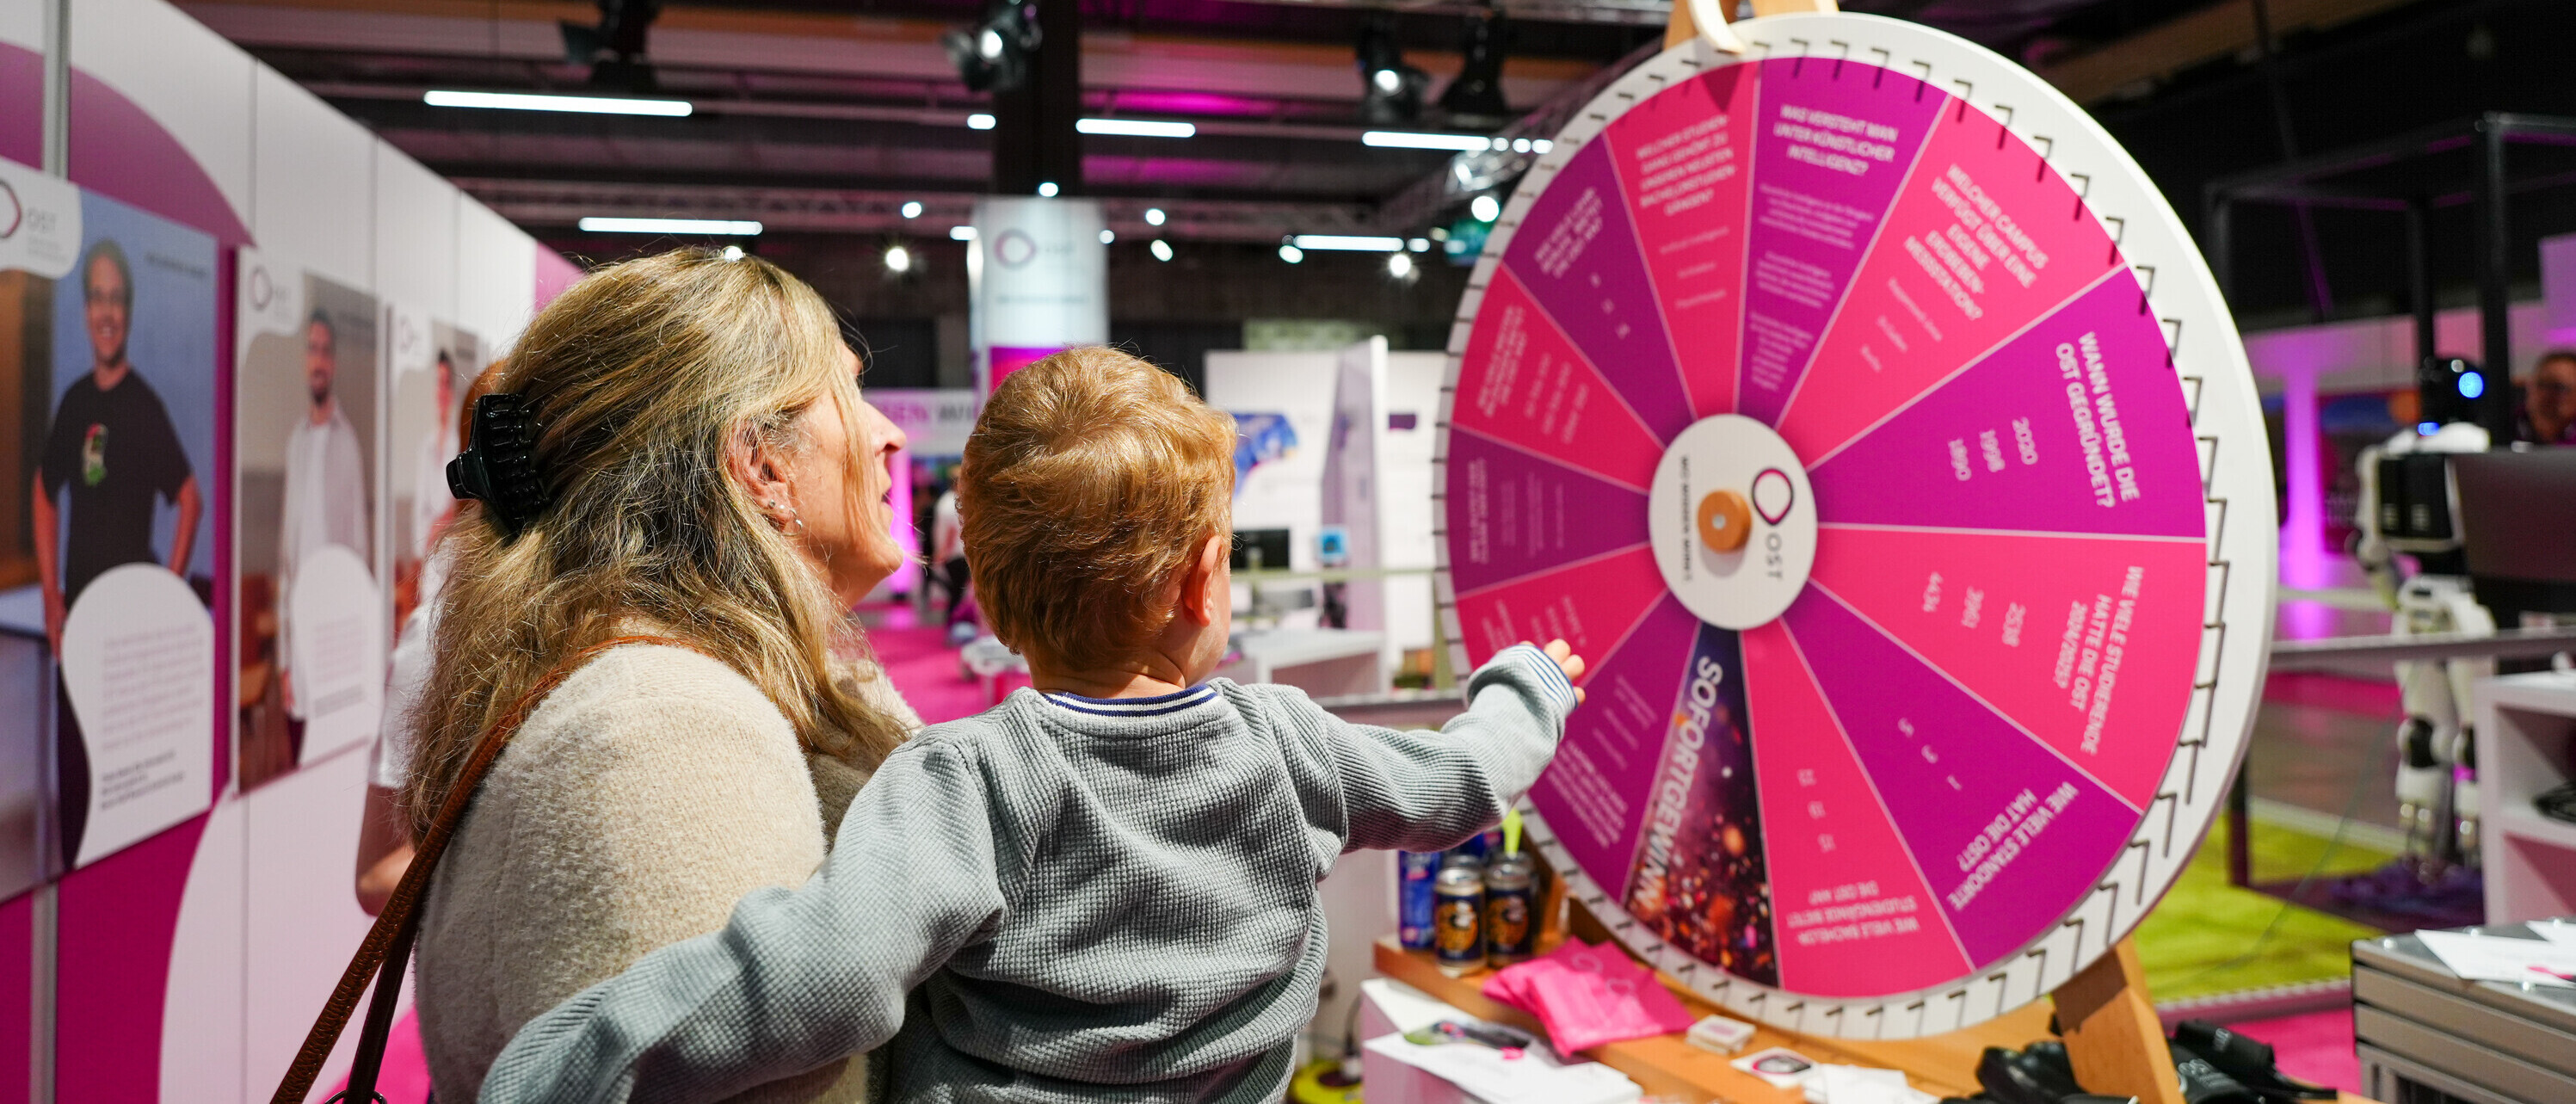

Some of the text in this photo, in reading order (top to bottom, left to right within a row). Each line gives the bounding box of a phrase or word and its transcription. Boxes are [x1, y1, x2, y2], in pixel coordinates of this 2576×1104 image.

[1928, 174, 2038, 289] VERFÜGT ÜBER EINE
[1944, 162, 2050, 271] WELCHER CAMPUS
[1944, 222, 1993, 271] EIGENE
[2011, 416, 2038, 466] 2020
[2054, 341, 2118, 509] OST GEGRÜNDET?
[2077, 331, 2140, 502] WANN WURDE DIE
[1764, 533, 1784, 579] OST
[2068, 594, 2113, 712] HATTE DIE OST
[2079, 564, 2145, 756] WIE VIELE STUDIERENDE
[1631, 655, 1725, 912] SOFORTGEWINN
[1918, 743, 1941, 765] 3
[1945, 778, 2080, 913] WIE VIELE STANDORTE
[1952, 786, 2039, 873] HAT DIE OST?
